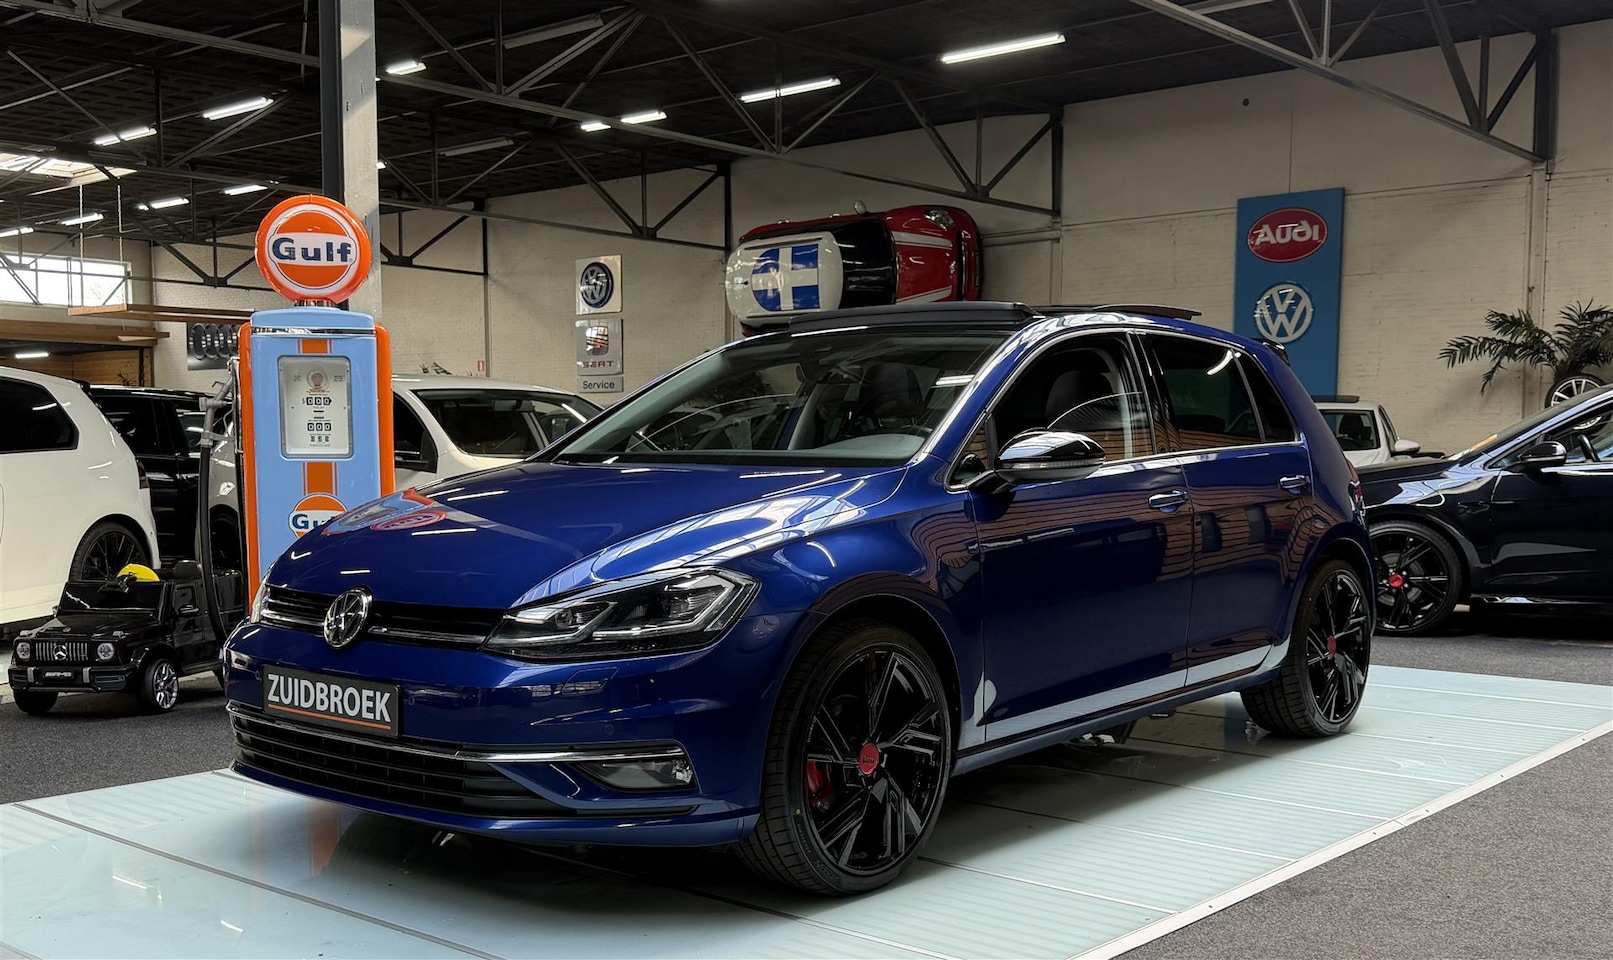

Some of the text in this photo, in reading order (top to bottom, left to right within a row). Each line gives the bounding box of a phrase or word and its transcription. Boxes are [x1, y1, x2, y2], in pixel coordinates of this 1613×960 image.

[272, 237, 351, 262] Gulf
[1258, 285, 1310, 341] VW
[582, 381, 615, 390] Service
[292, 513, 327, 529] Gu
[267, 673, 391, 722] ZUIDBROEK
